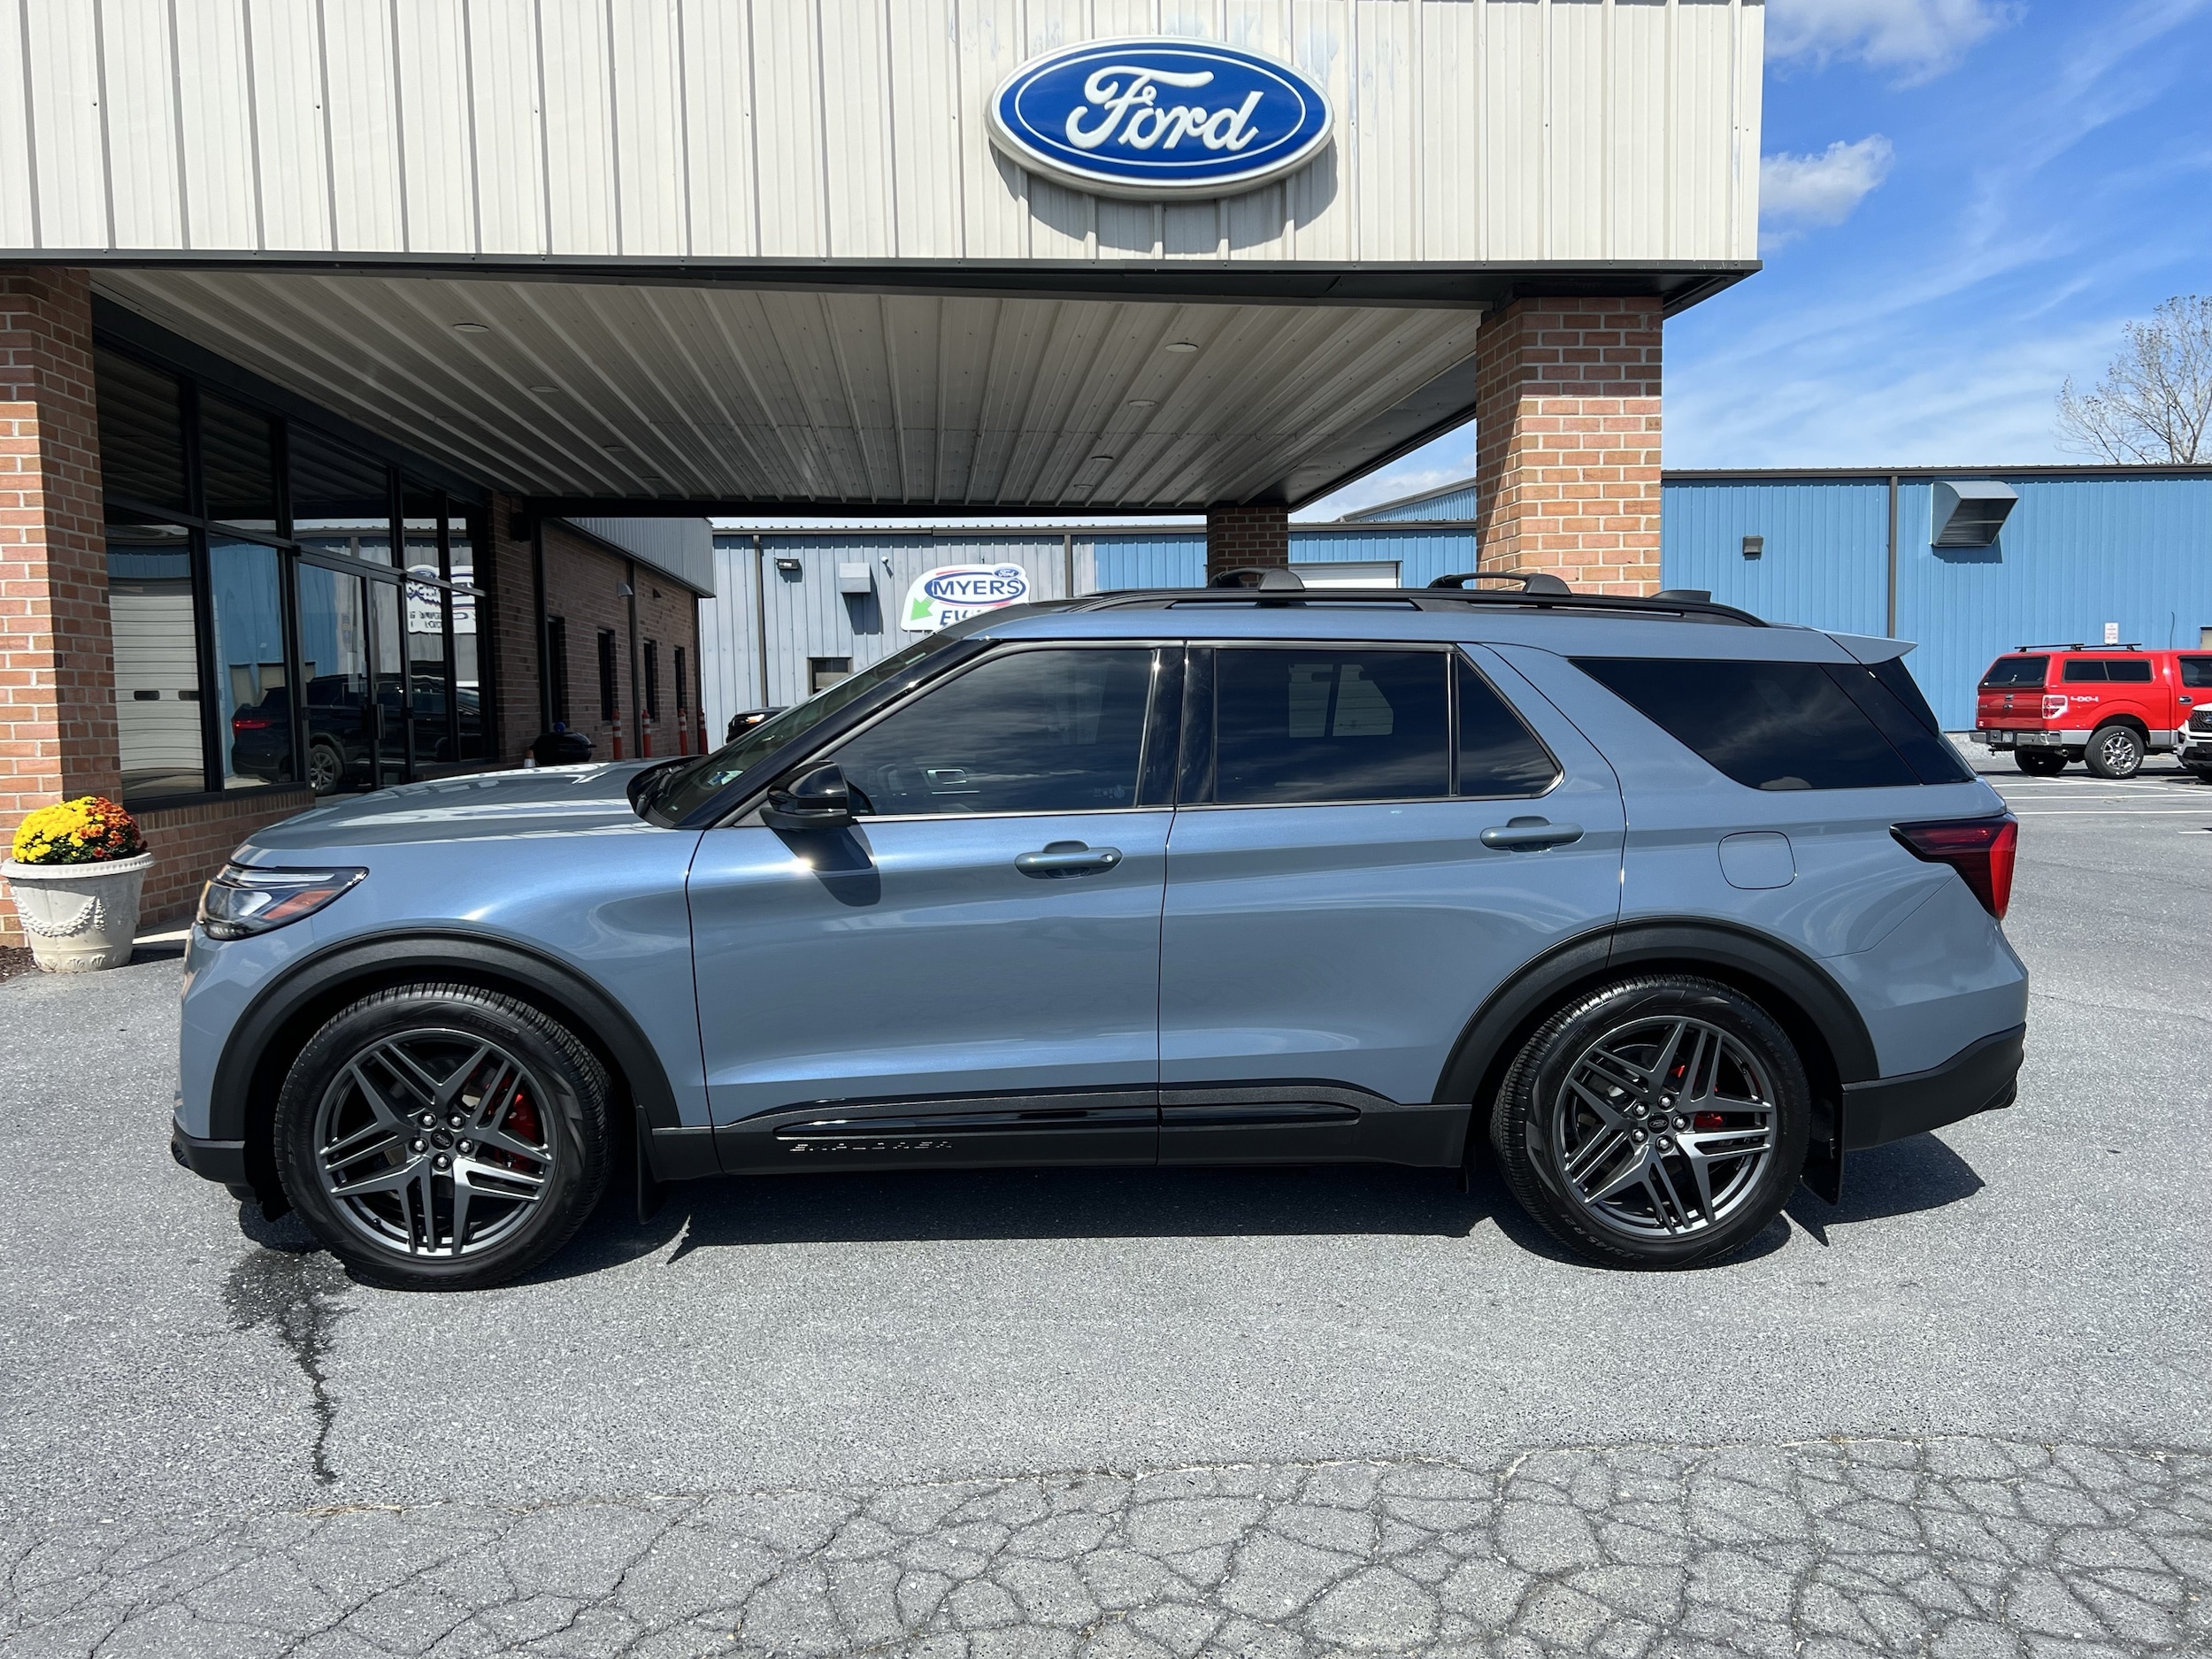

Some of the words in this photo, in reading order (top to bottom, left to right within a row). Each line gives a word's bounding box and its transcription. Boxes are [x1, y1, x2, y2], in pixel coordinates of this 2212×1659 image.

[1065, 65, 1264, 150] Ford
[997, 569, 1017, 578] Ford
[933, 580, 1020, 595] MYERS
